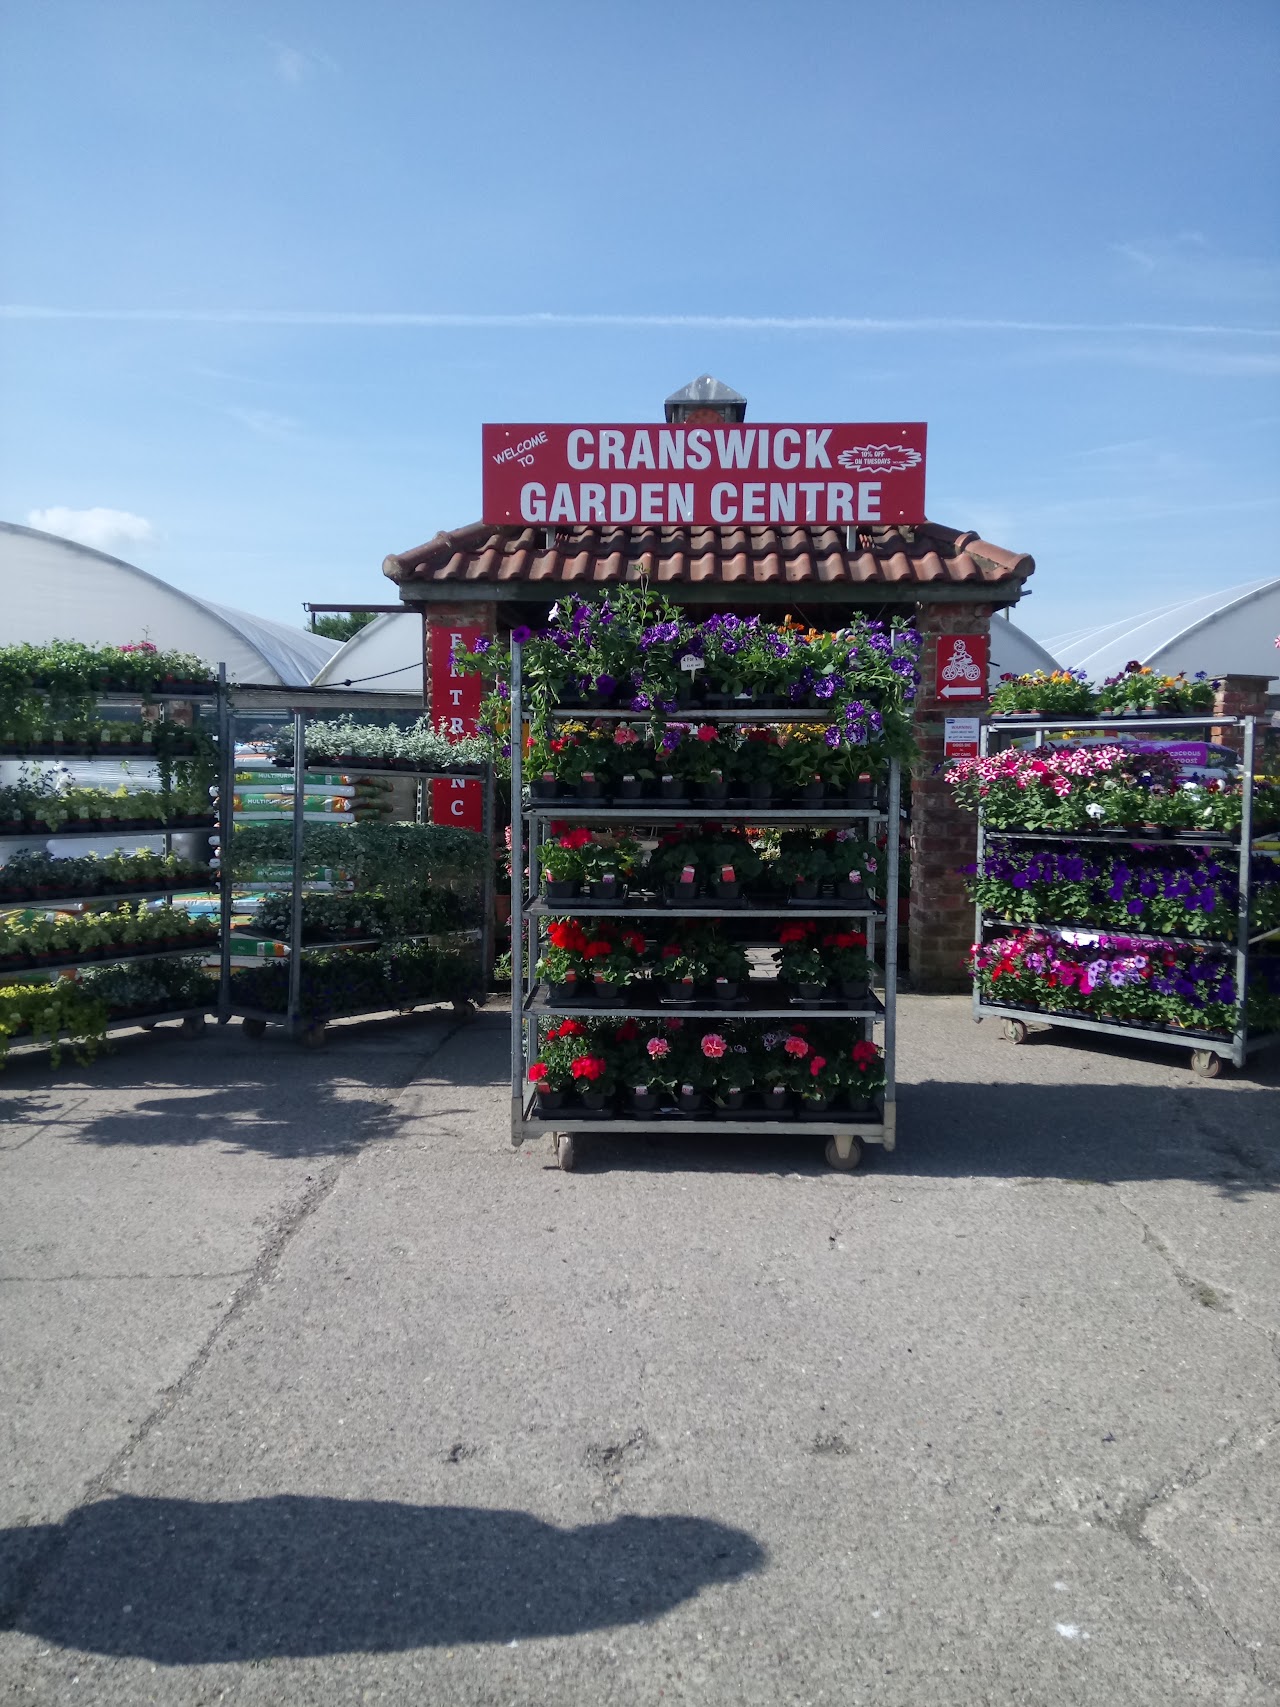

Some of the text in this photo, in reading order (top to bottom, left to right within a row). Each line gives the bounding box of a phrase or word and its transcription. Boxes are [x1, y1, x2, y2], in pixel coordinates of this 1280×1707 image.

[492, 431, 548, 464] WELCOME
[517, 454, 535, 467] TO
[566, 428, 833, 470] CRANSWICK
[520, 481, 882, 523] GARDEN CENTRE
[450, 633, 466, 816] ENTRNC
